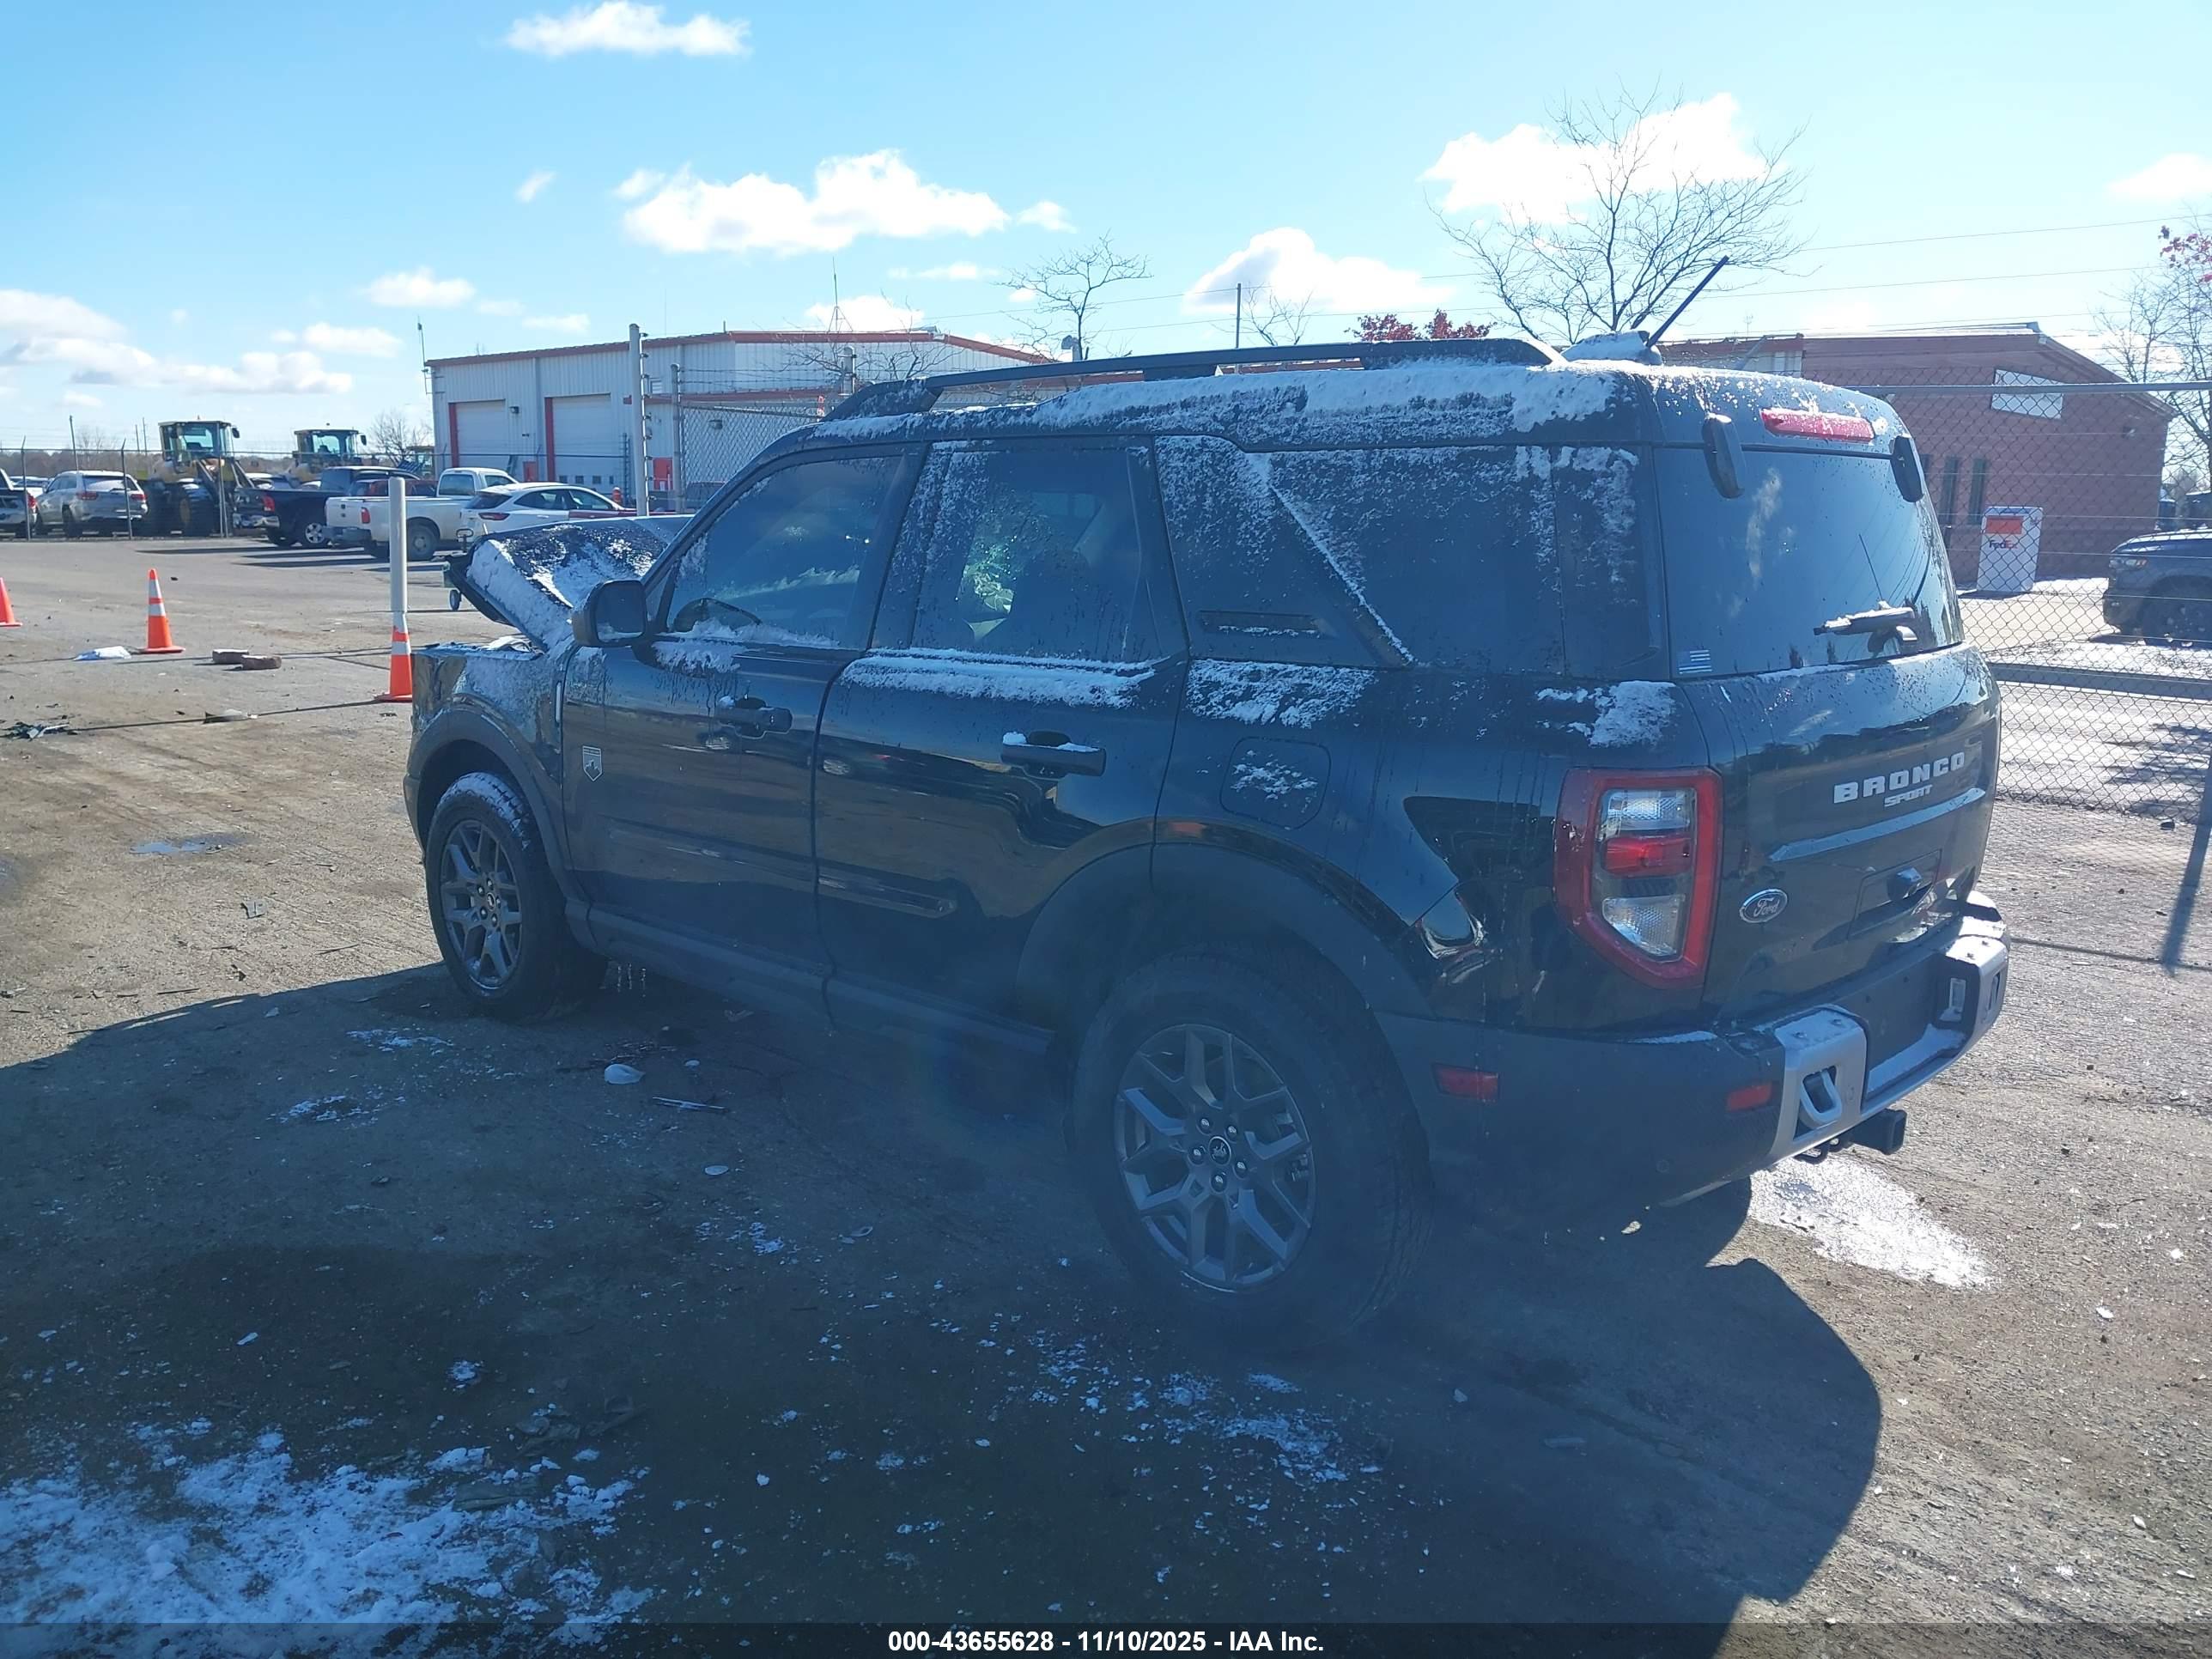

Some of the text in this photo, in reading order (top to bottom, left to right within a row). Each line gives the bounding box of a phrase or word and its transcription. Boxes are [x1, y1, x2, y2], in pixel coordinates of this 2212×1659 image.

[1989, 539, 2018, 550] FedEx
[1833, 751, 1966, 804] BRONCO
[1884, 784, 1933, 807] SPORT
[1753, 896, 1781, 918] Ford
